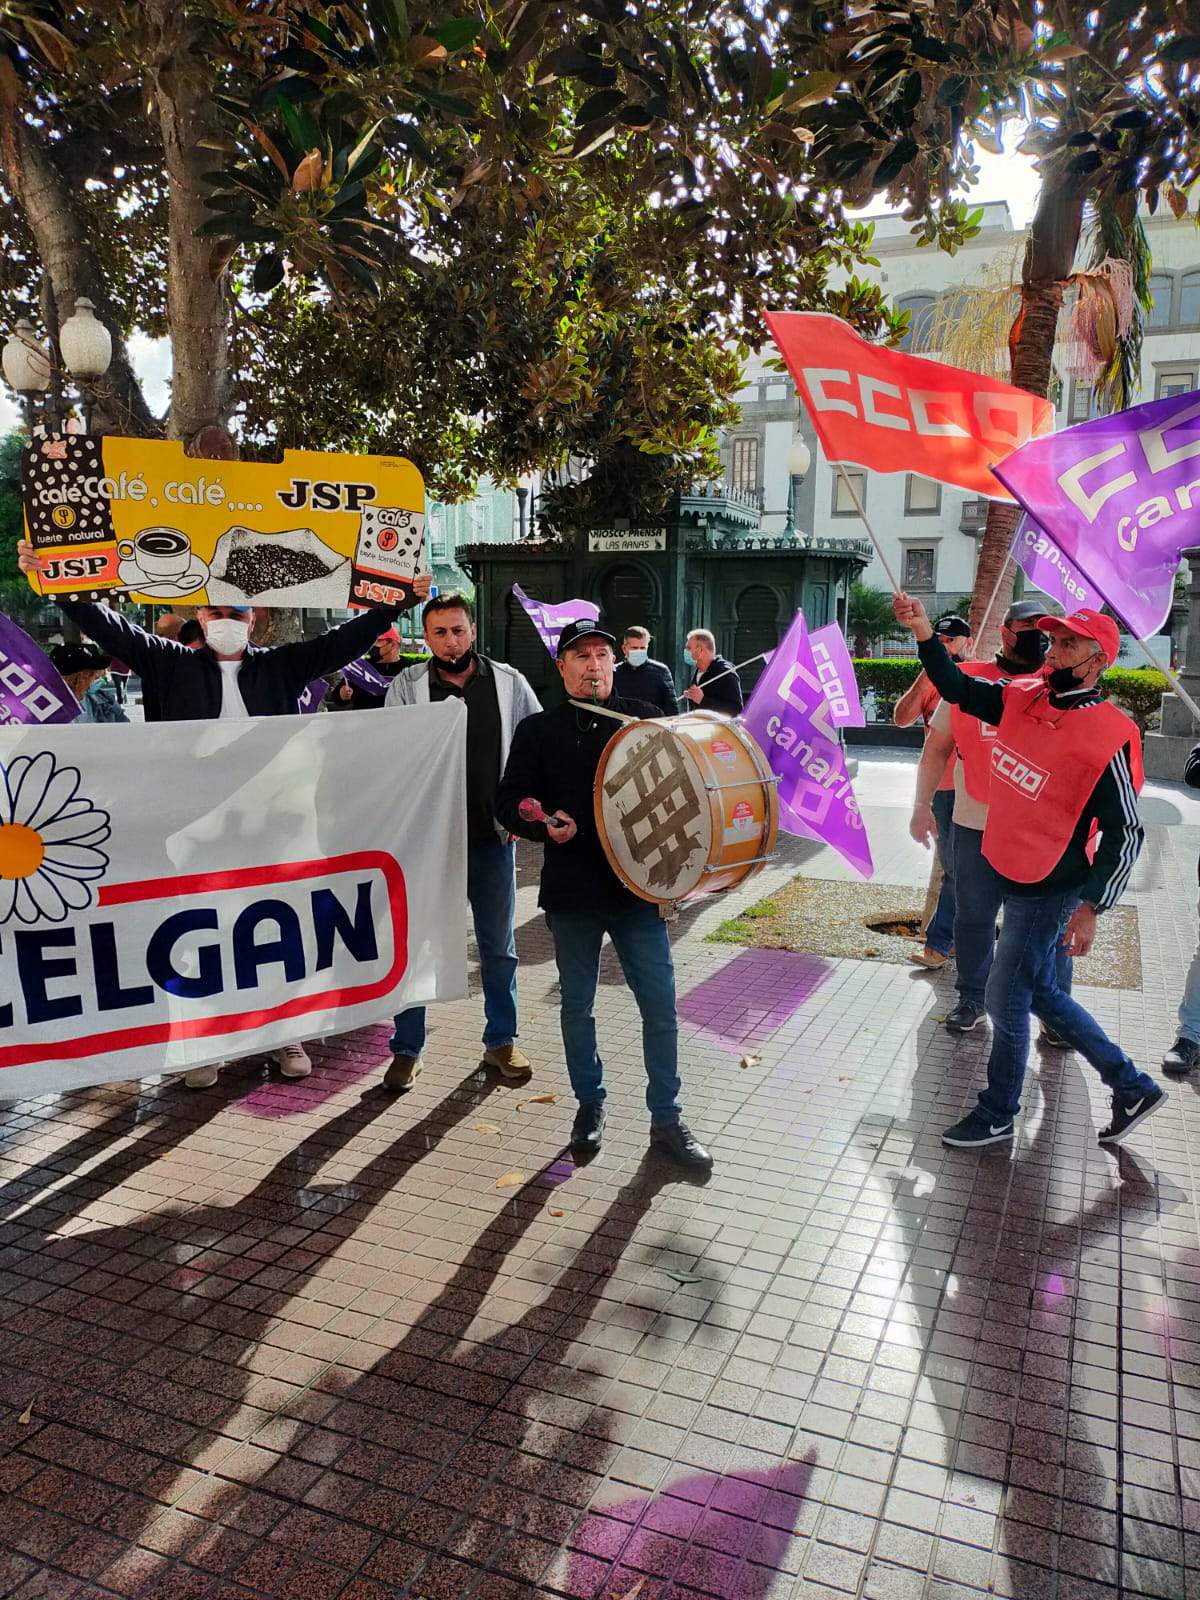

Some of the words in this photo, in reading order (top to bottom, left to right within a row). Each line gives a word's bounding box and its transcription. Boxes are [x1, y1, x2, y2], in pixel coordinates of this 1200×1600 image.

[802, 367, 1033, 448] CCOO
[39, 483, 82, 505] café
[276, 479, 377, 513] JSP
[377, 510, 412, 528] café
[68, 529, 105, 541] natural
[41, 555, 108, 579] JSP
[354, 580, 406, 605] JSP
[811, 642, 850, 718] CCOO
[992, 746, 1043, 793] CCOO
[0, 880, 380, 1028] ELGAN
